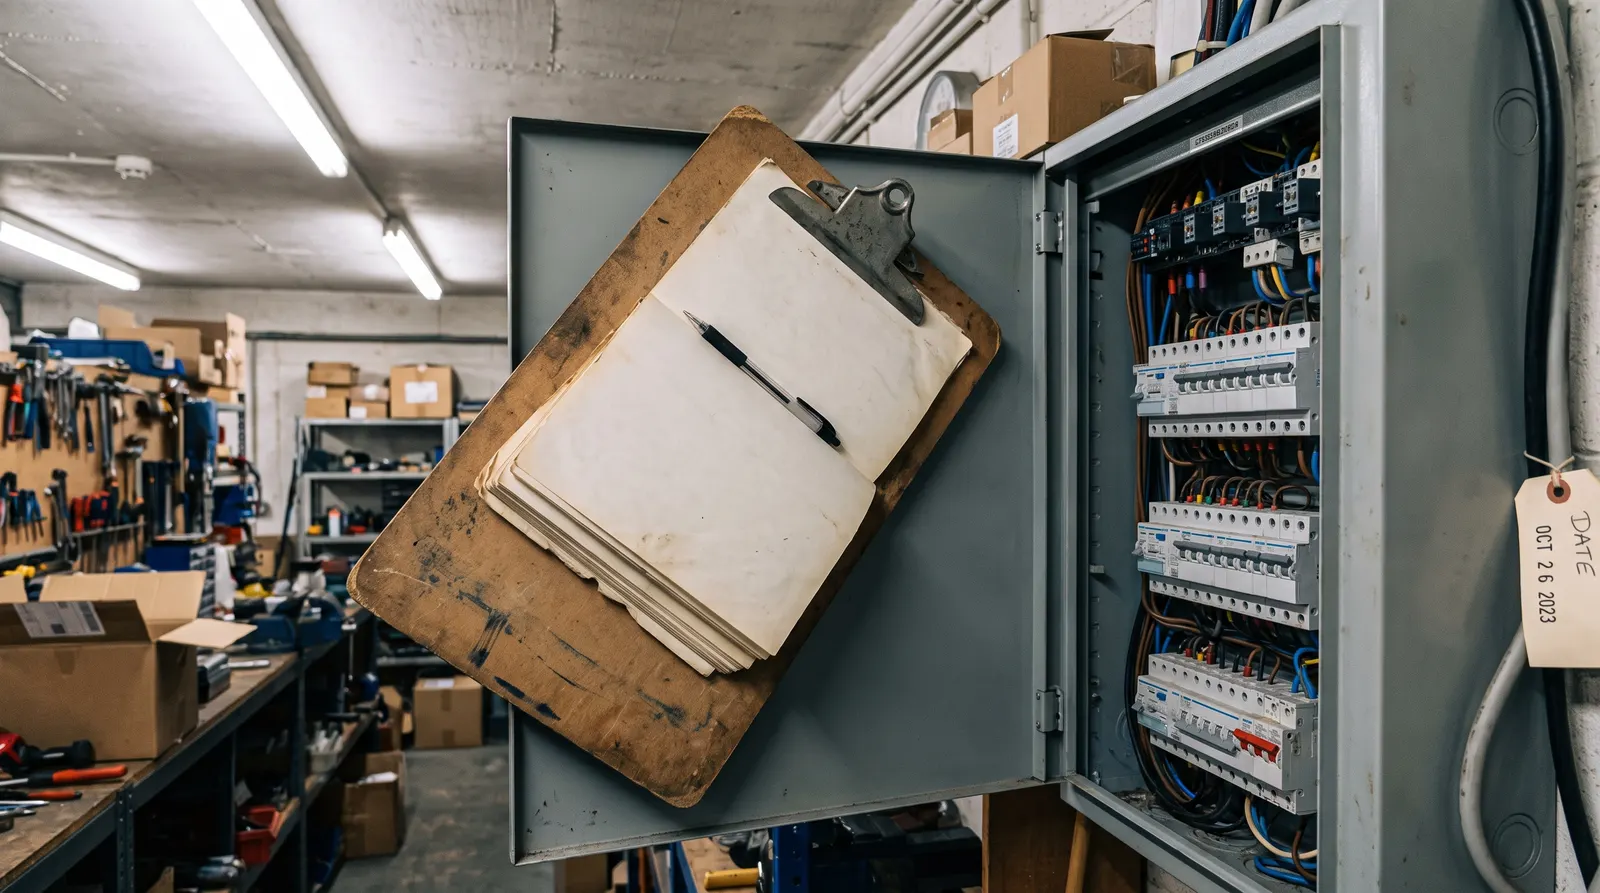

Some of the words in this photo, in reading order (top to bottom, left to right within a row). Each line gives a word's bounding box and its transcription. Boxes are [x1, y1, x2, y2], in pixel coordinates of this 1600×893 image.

[1536, 525, 1553, 551] OCT
[1571, 510, 1596, 576] DATE
[1538, 592, 1557, 623] 2023
